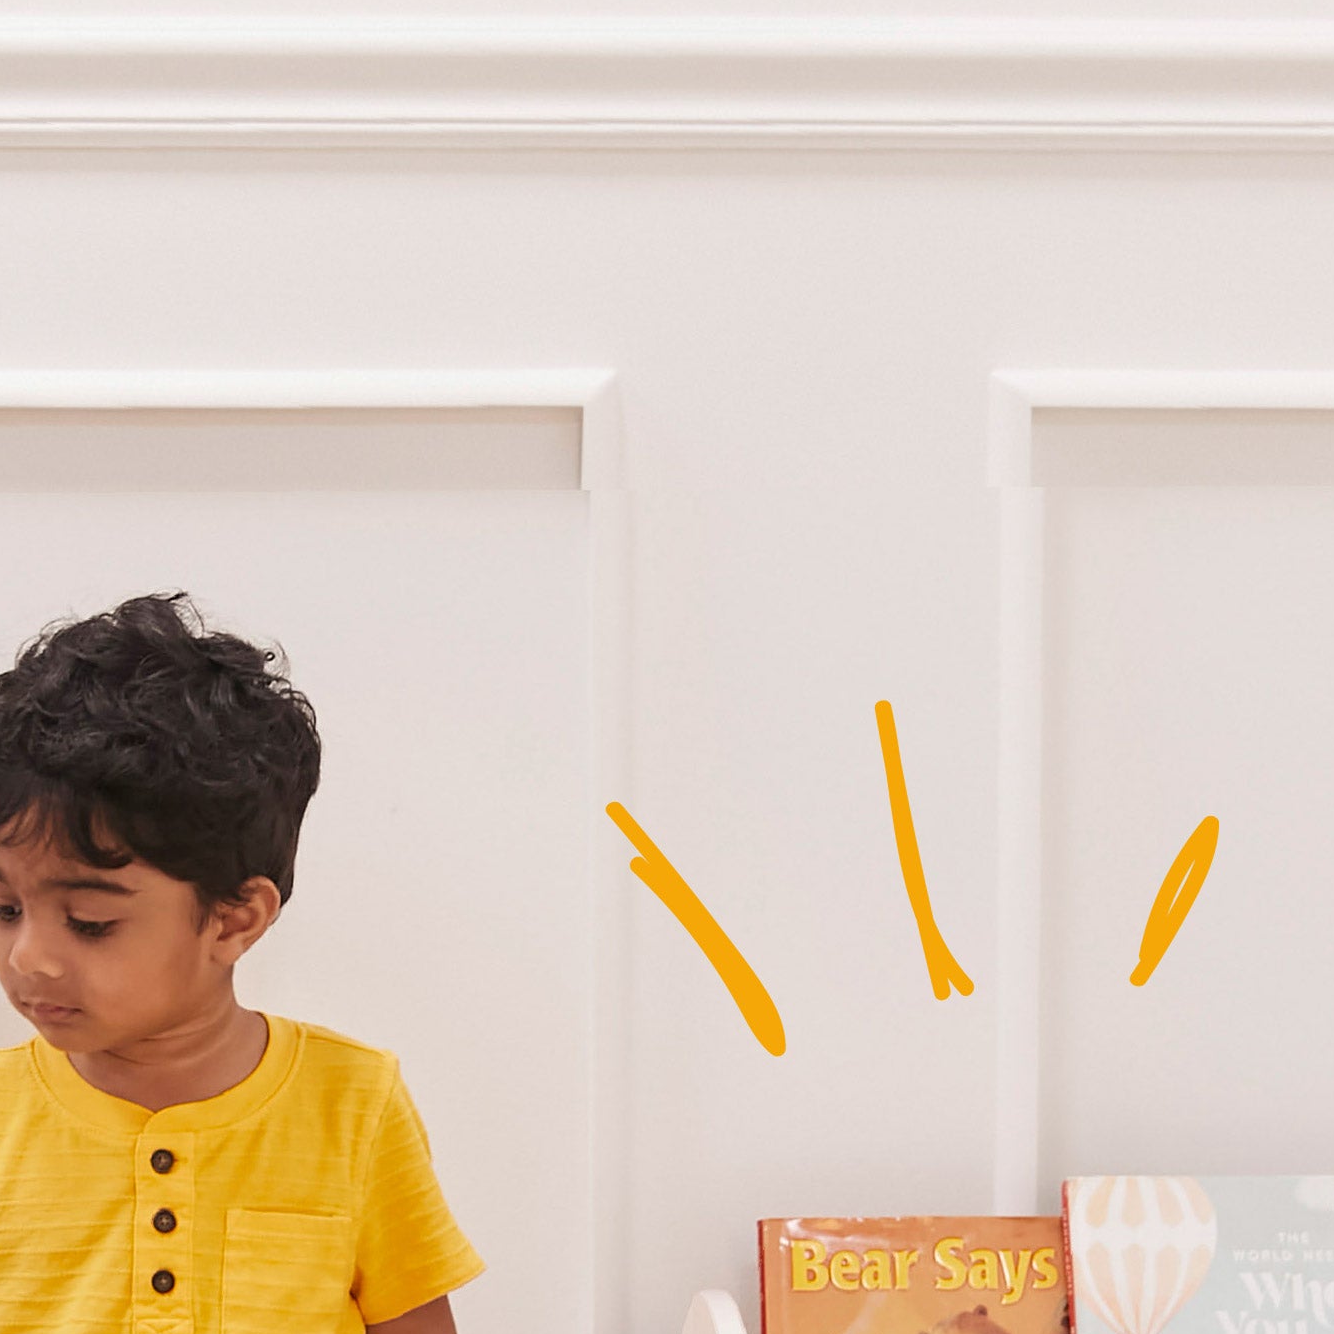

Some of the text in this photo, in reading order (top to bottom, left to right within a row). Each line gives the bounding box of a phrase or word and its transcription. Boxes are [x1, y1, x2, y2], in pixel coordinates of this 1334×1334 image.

[1278, 1231, 1309, 1243] THE
[1233, 1249, 1293, 1262] WORLD
[790, 1238, 919, 1291] Bear
[933, 1237, 1059, 1305] Says
